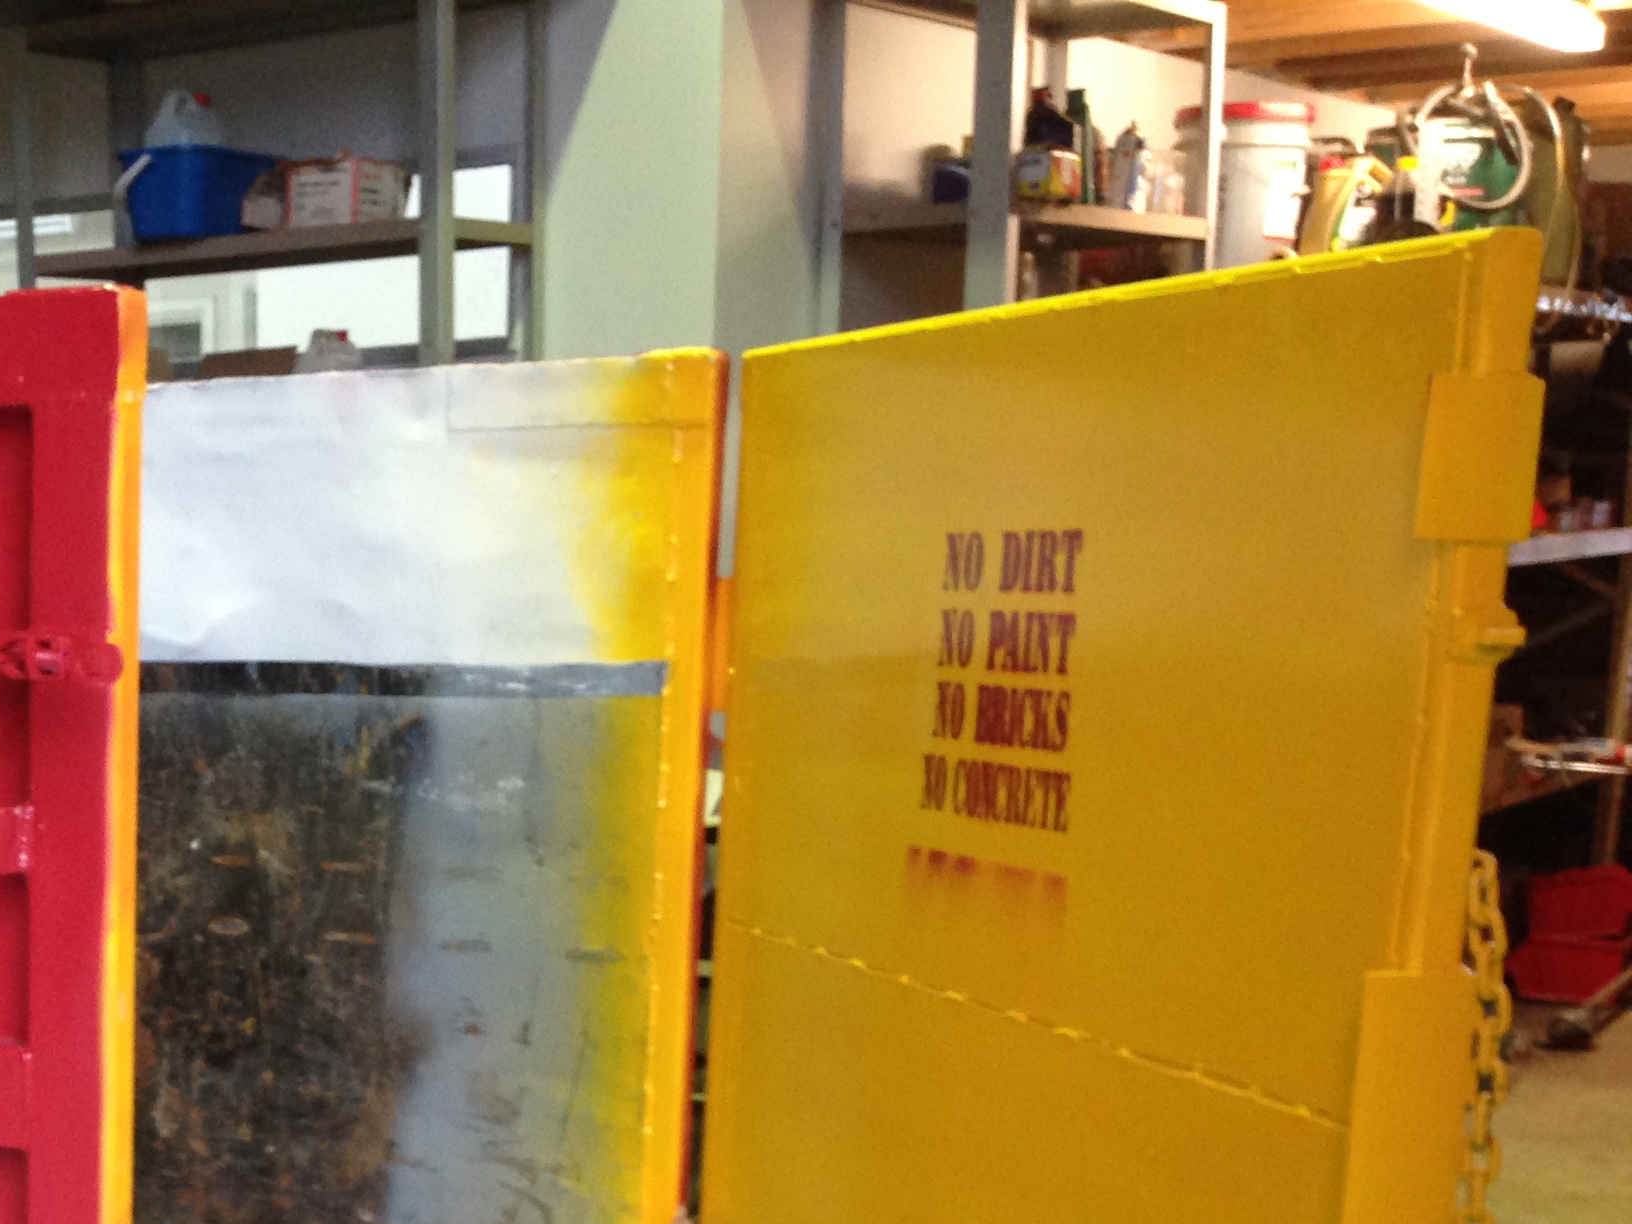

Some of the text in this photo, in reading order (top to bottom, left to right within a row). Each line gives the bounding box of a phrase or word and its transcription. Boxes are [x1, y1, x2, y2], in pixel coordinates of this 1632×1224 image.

[942, 529, 1083, 593] NO DIRT
[937, 607, 1077, 675] NO PAINT
[932, 681, 1071, 752] NO BRICKS
[920, 754, 1072, 833] NO CONCRETE
